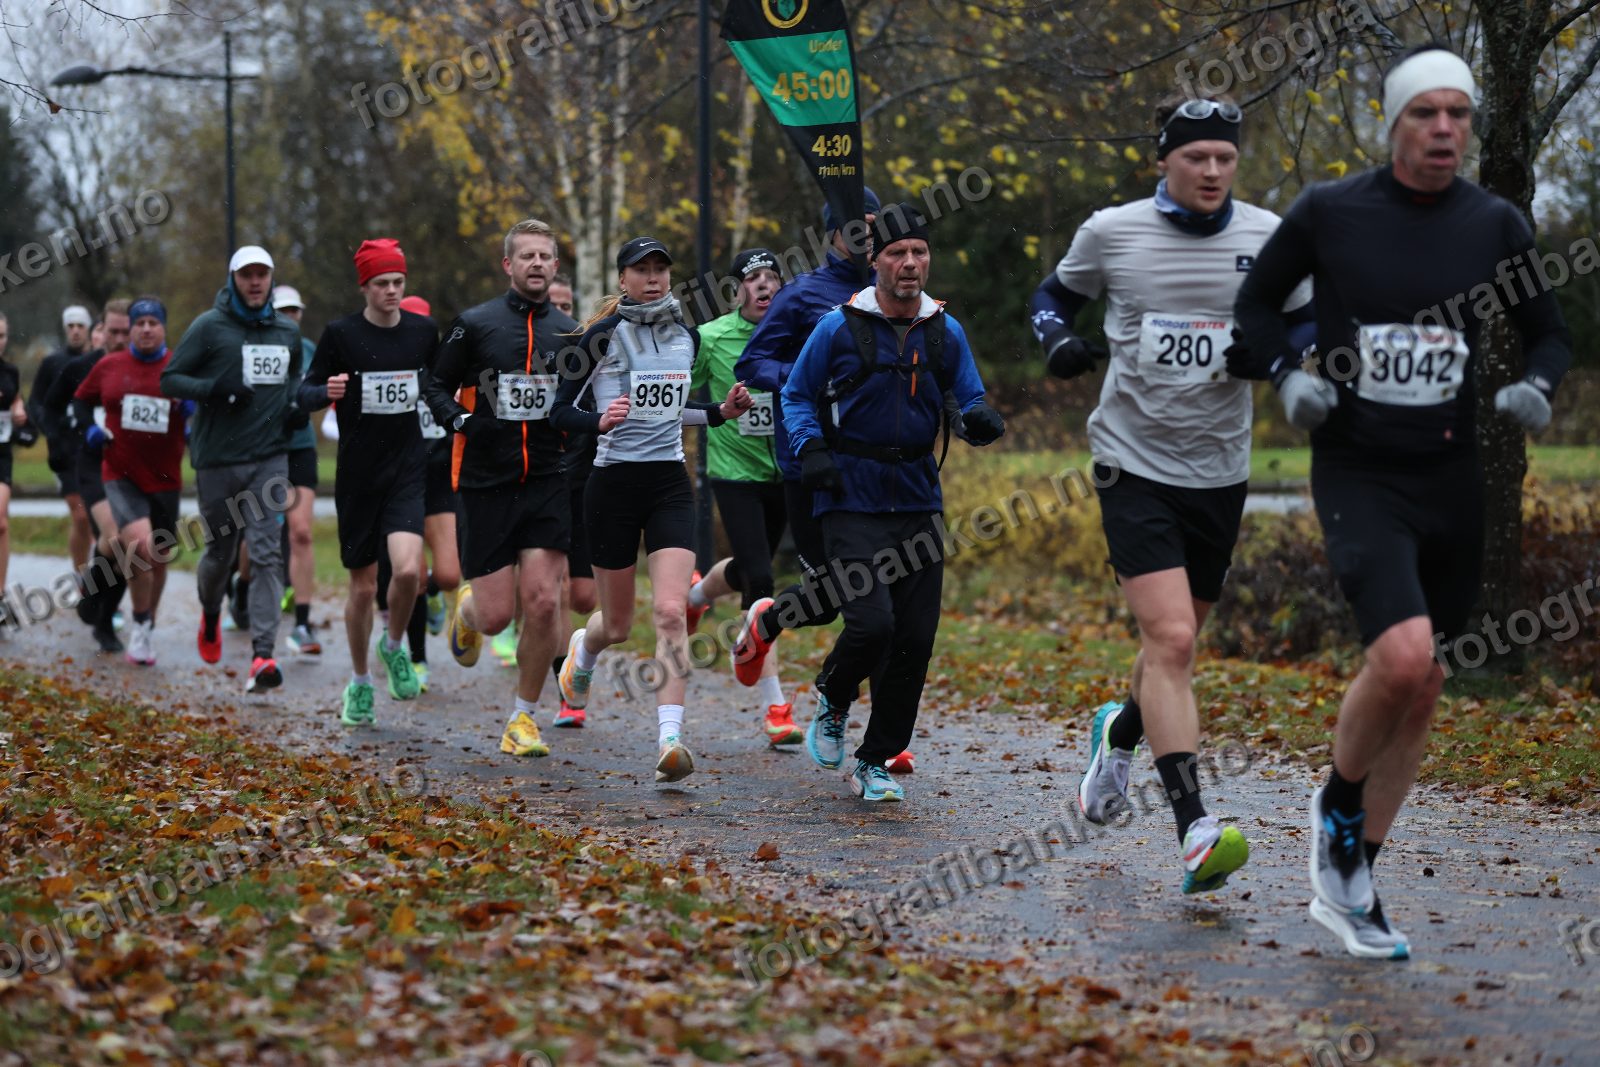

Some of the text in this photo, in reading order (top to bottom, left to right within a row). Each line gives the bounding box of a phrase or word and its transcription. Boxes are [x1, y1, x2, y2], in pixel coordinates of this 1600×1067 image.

[809, 39, 842, 53] Under
[772, 68, 850, 101] 45:00
[811, 134, 852, 157] 4:30
[1152, 319, 1227, 329] NORGESTESTEN
[1156, 333, 1212, 367] 280
[253, 357, 281, 375] 562
[1370, 348, 1457, 385] 3042
[375, 383, 408, 404] 165
[509, 387, 547, 410] 385
[635, 383, 684, 408] 9361
[131, 405, 160, 424] 824
[749, 406, 773, 427] 53
